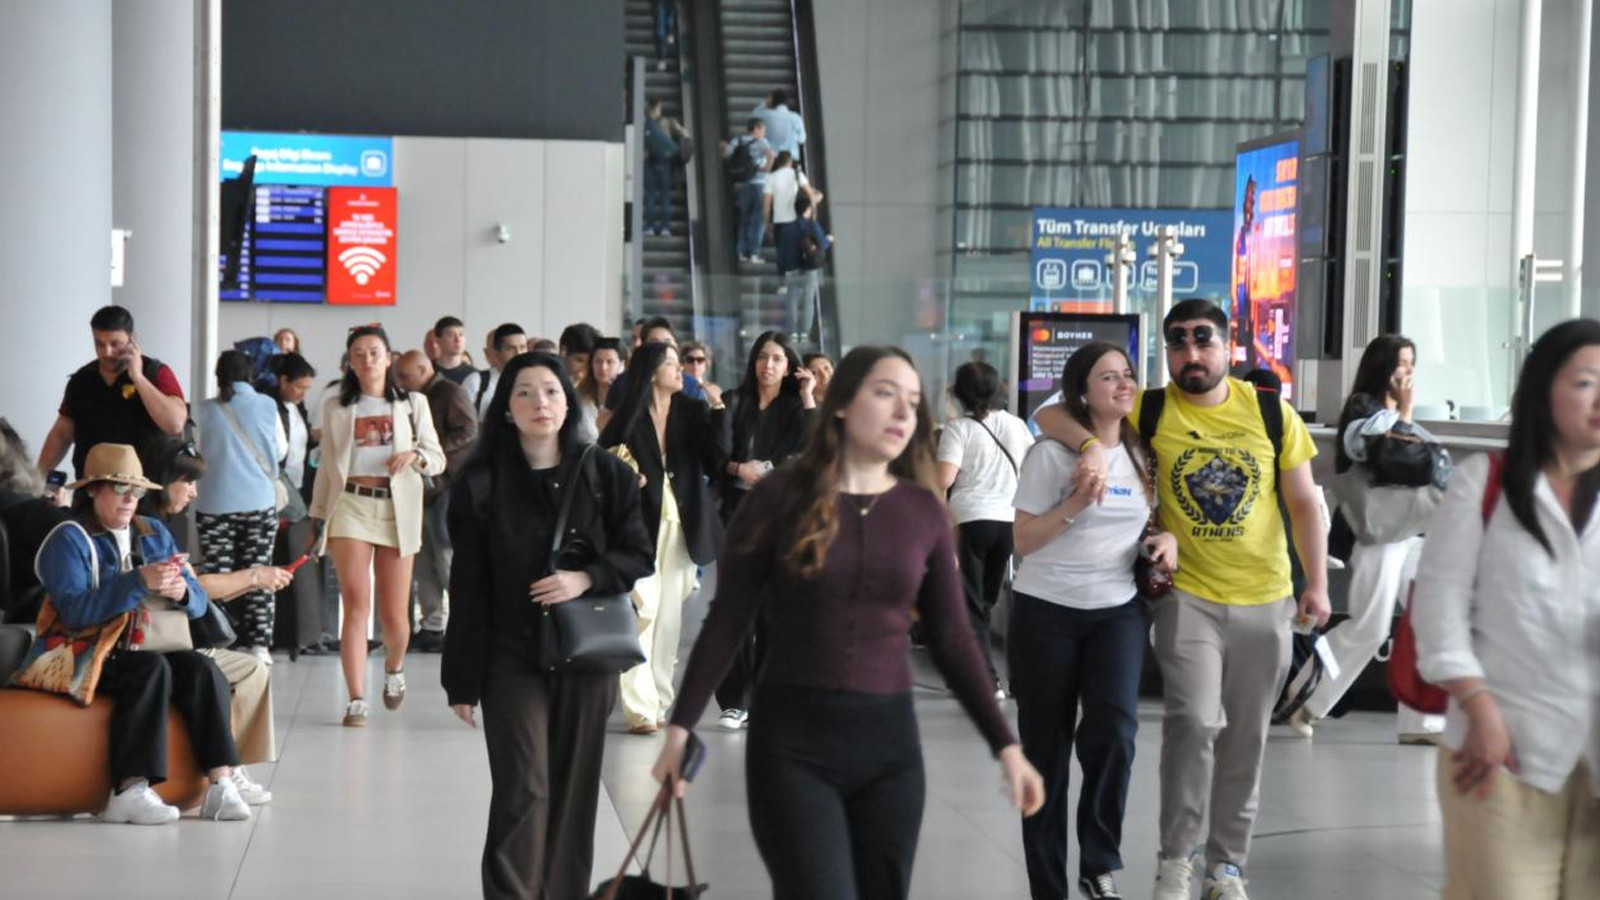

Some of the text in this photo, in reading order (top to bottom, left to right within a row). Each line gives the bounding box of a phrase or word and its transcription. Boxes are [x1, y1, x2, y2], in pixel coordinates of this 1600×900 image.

[1037, 218, 1071, 234] Tüm
[1074, 219, 1138, 235] Transfer
[1053, 237, 1098, 249] Transfer
